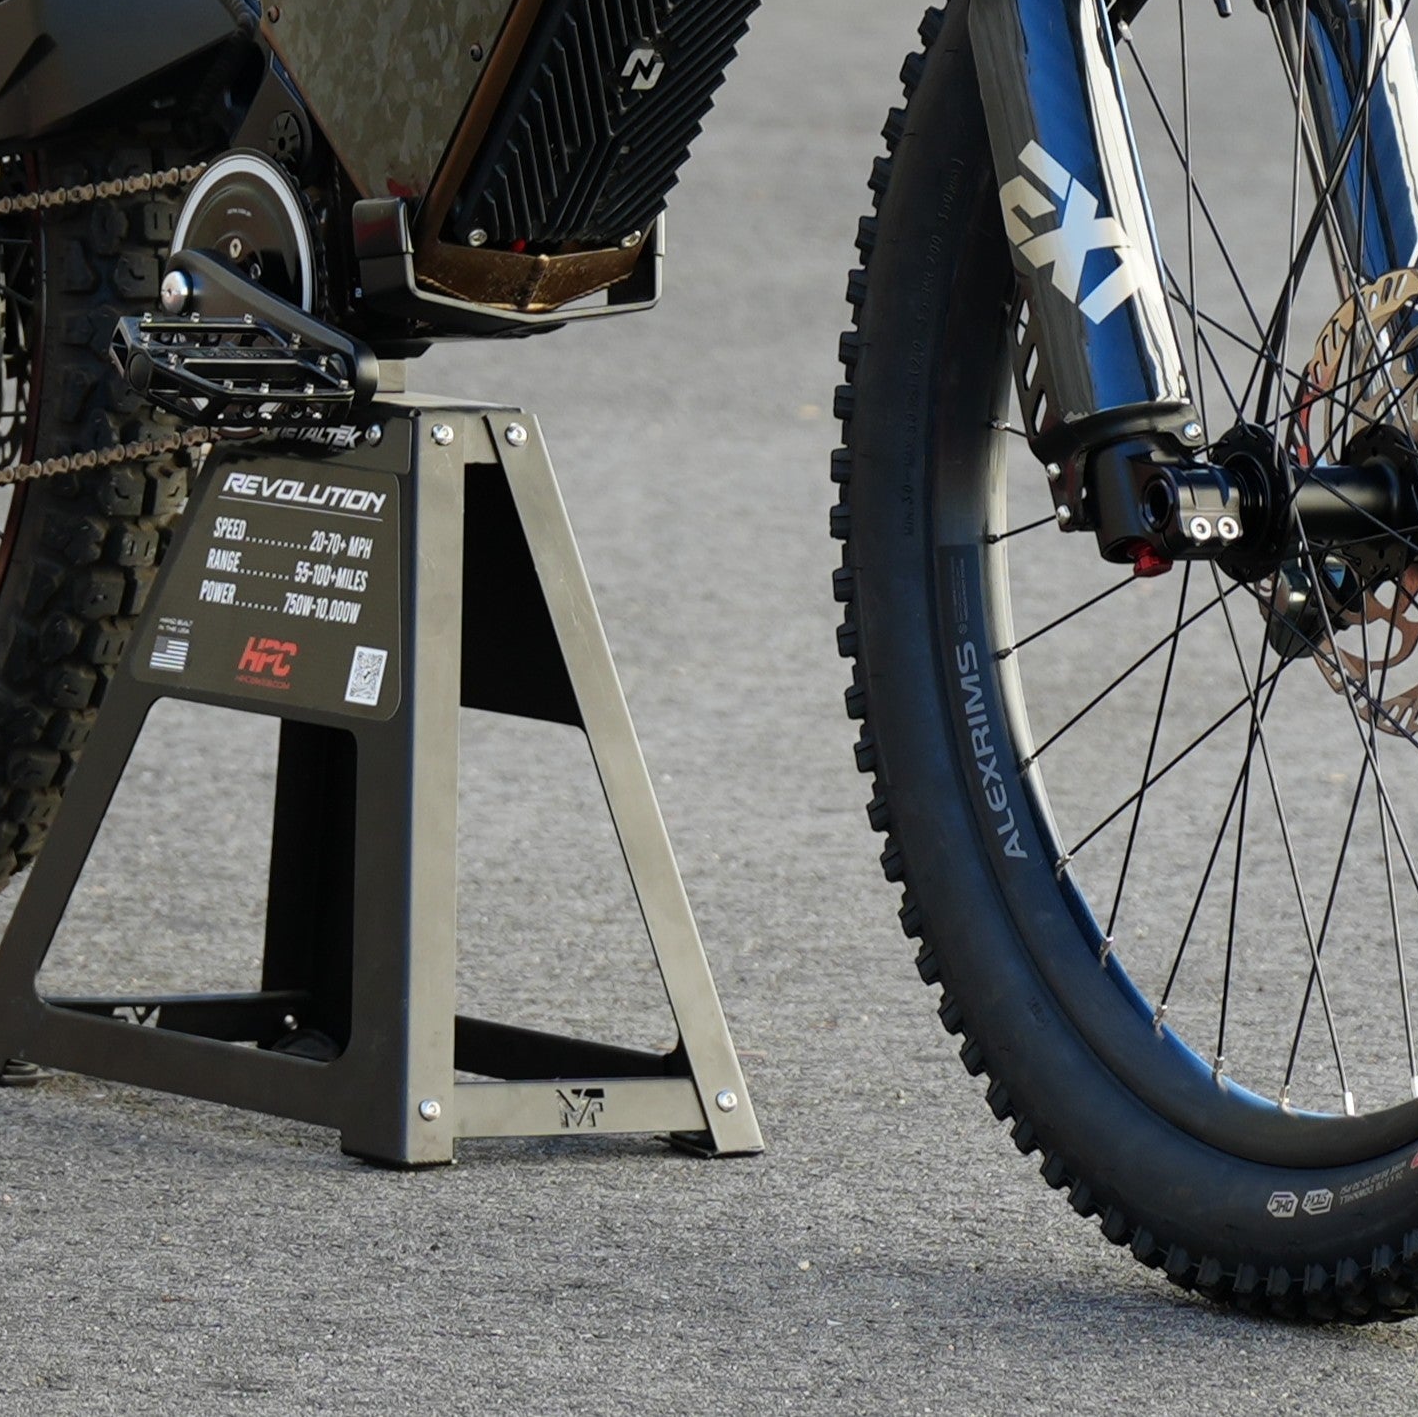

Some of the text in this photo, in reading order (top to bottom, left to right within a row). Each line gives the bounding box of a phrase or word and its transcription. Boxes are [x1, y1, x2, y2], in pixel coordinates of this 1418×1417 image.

[222, 472, 386, 513] REVOLUTION
[347, 536, 373, 560] MPH
[282, 592, 362, 624] 750W-10,000W
[238, 636, 298, 677] HPC
[955, 640, 1029, 860] ALEXRIMS
